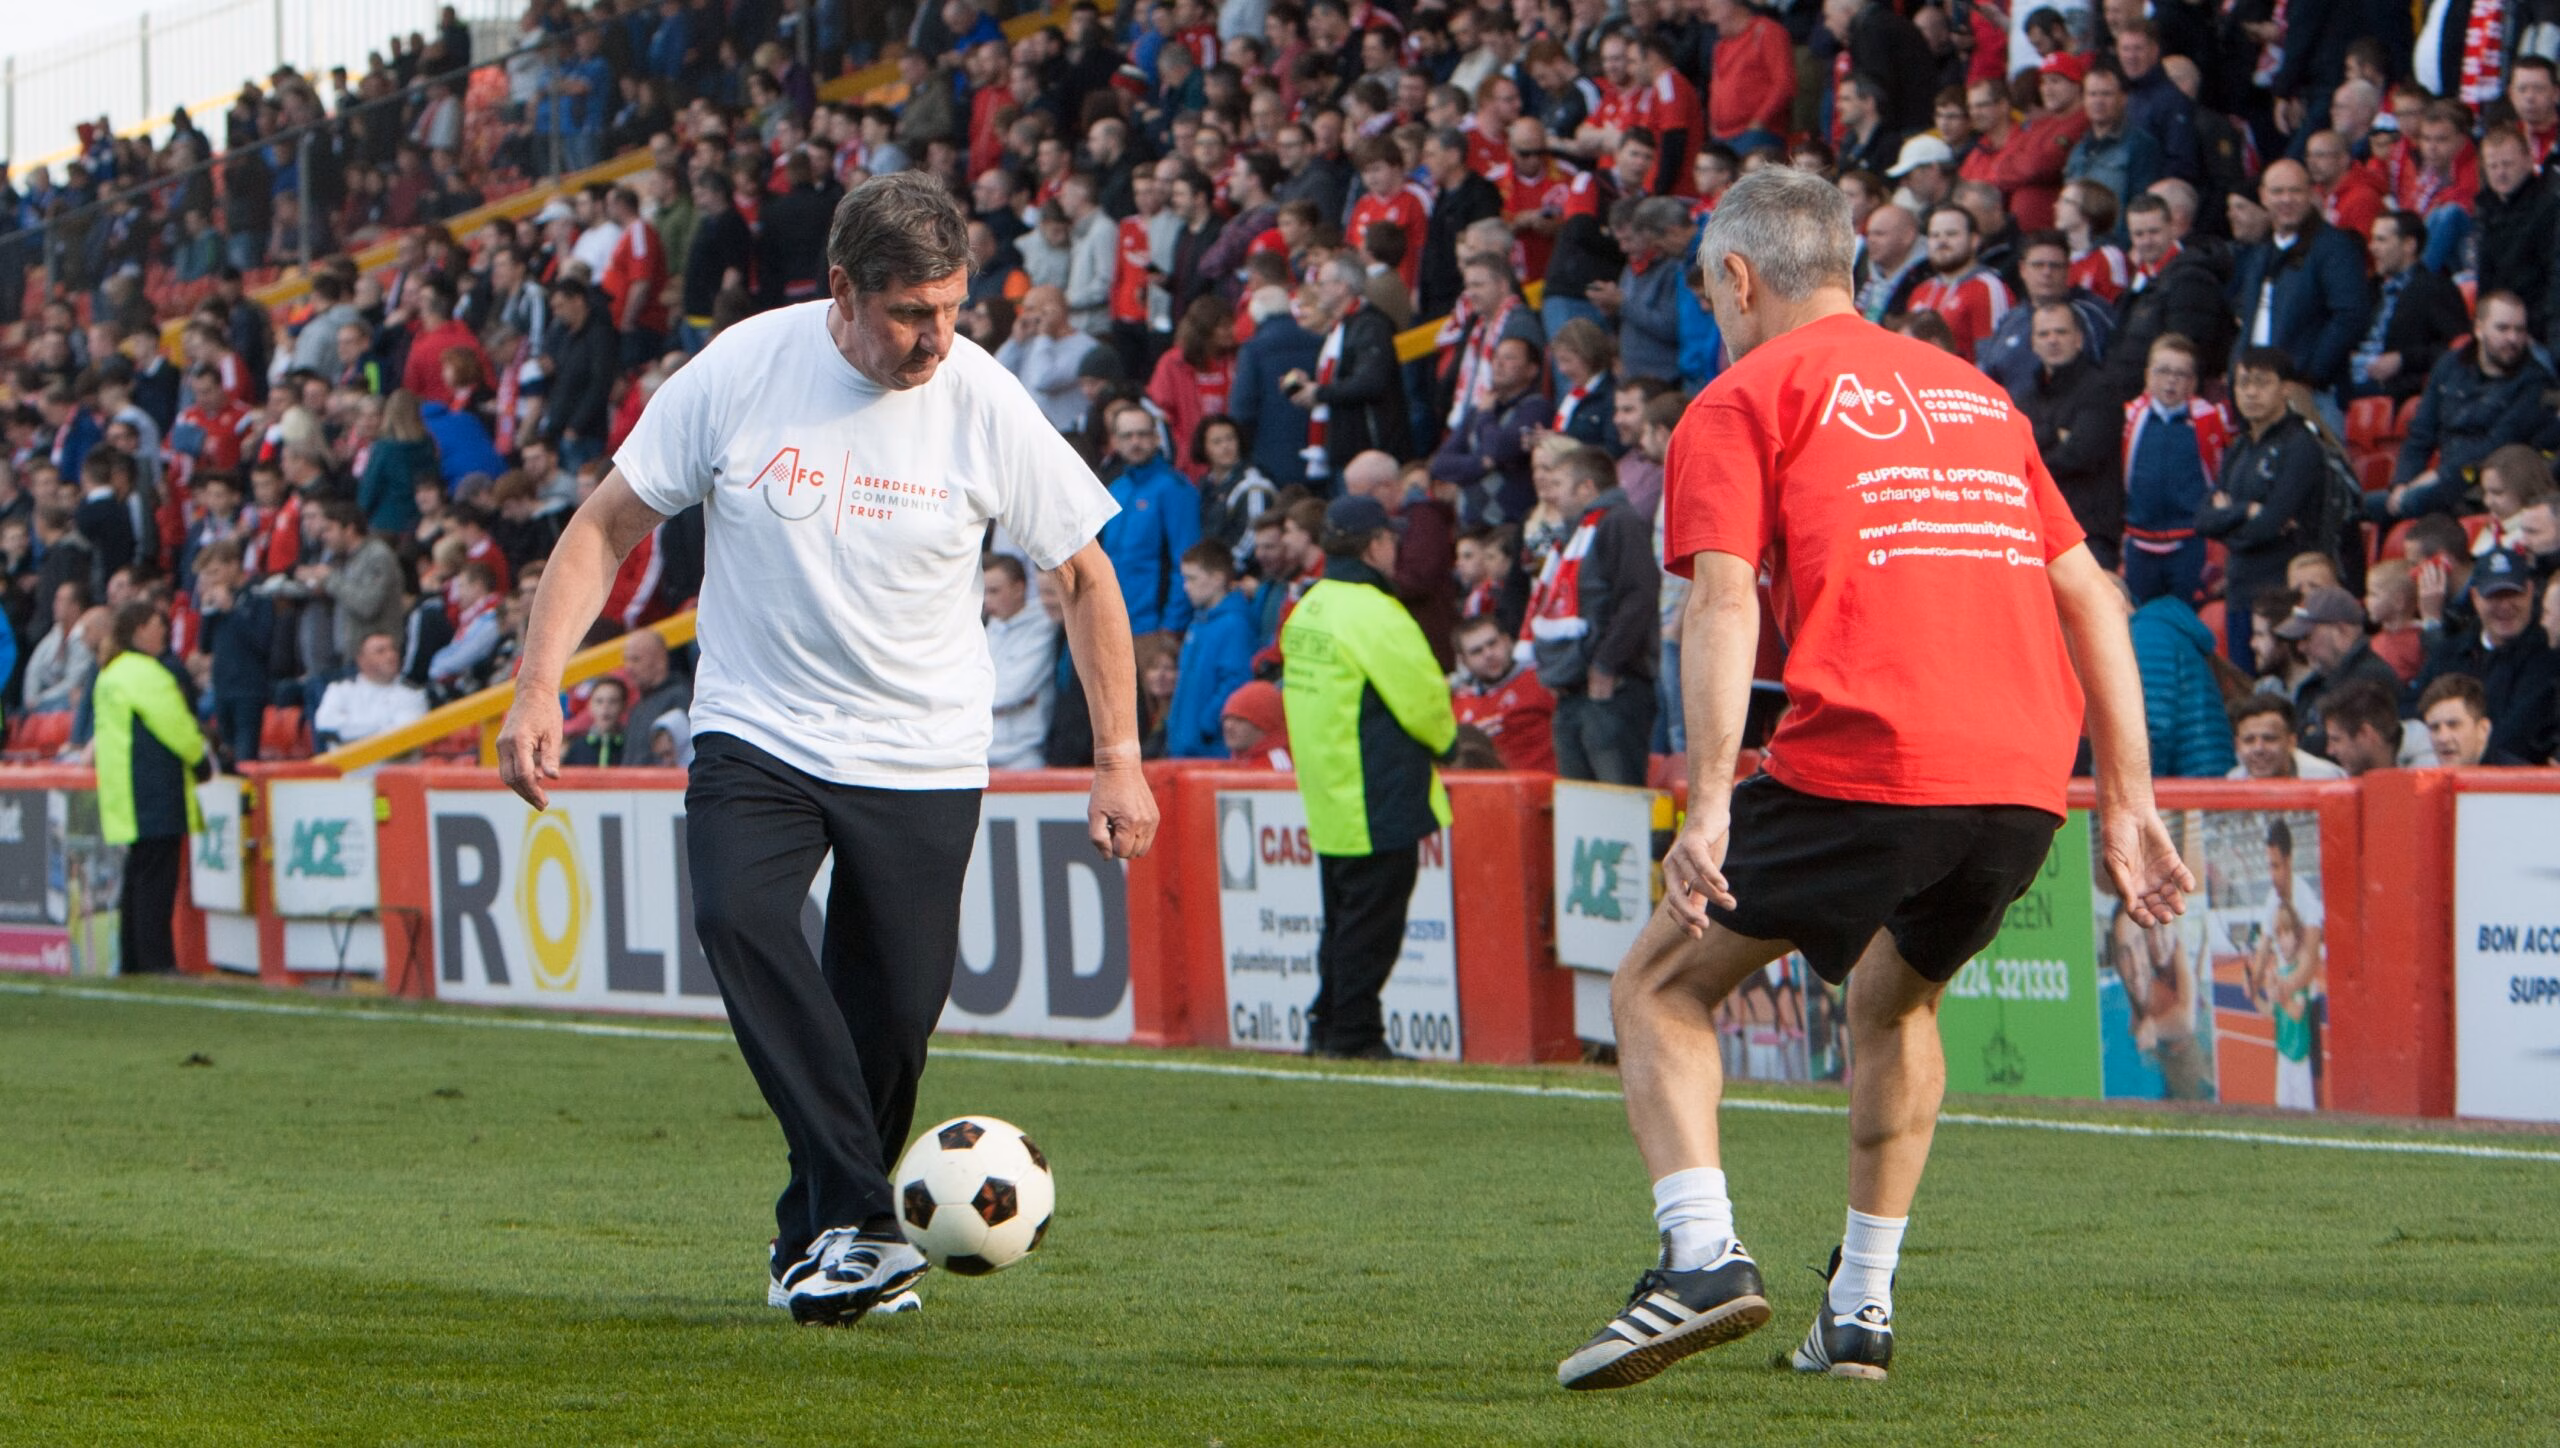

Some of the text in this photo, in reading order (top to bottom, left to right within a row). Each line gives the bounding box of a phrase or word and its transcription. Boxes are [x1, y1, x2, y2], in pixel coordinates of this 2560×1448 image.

[1918, 388, 2009, 411] ABERDEEN FC
[1923, 400, 2009, 422] COMMUNITY
[1929, 411, 1975, 425] TRUST
[1932, 468, 1945, 482] &
[853, 475, 949, 500] ABERDEEN FC
[1861, 491, 1878, 504] to
[1879, 487, 1931, 503] change
[1931, 486, 1959, 502] lives
[1961, 487, 1982, 500] for
[1983, 488, 2004, 503] the
[849, 505, 894, 521] TRUST
[851, 489, 941, 513] COMMUNITY
[286, 817, 349, 877] ACE
[1565, 836, 1628, 922] ACE
[2477, 924, 2519, 953] BON
[1995, 959, 2069, 1001] 321333
[1233, 1002, 1282, 1041] Call:
[1410, 1012, 1453, 1052] 000
